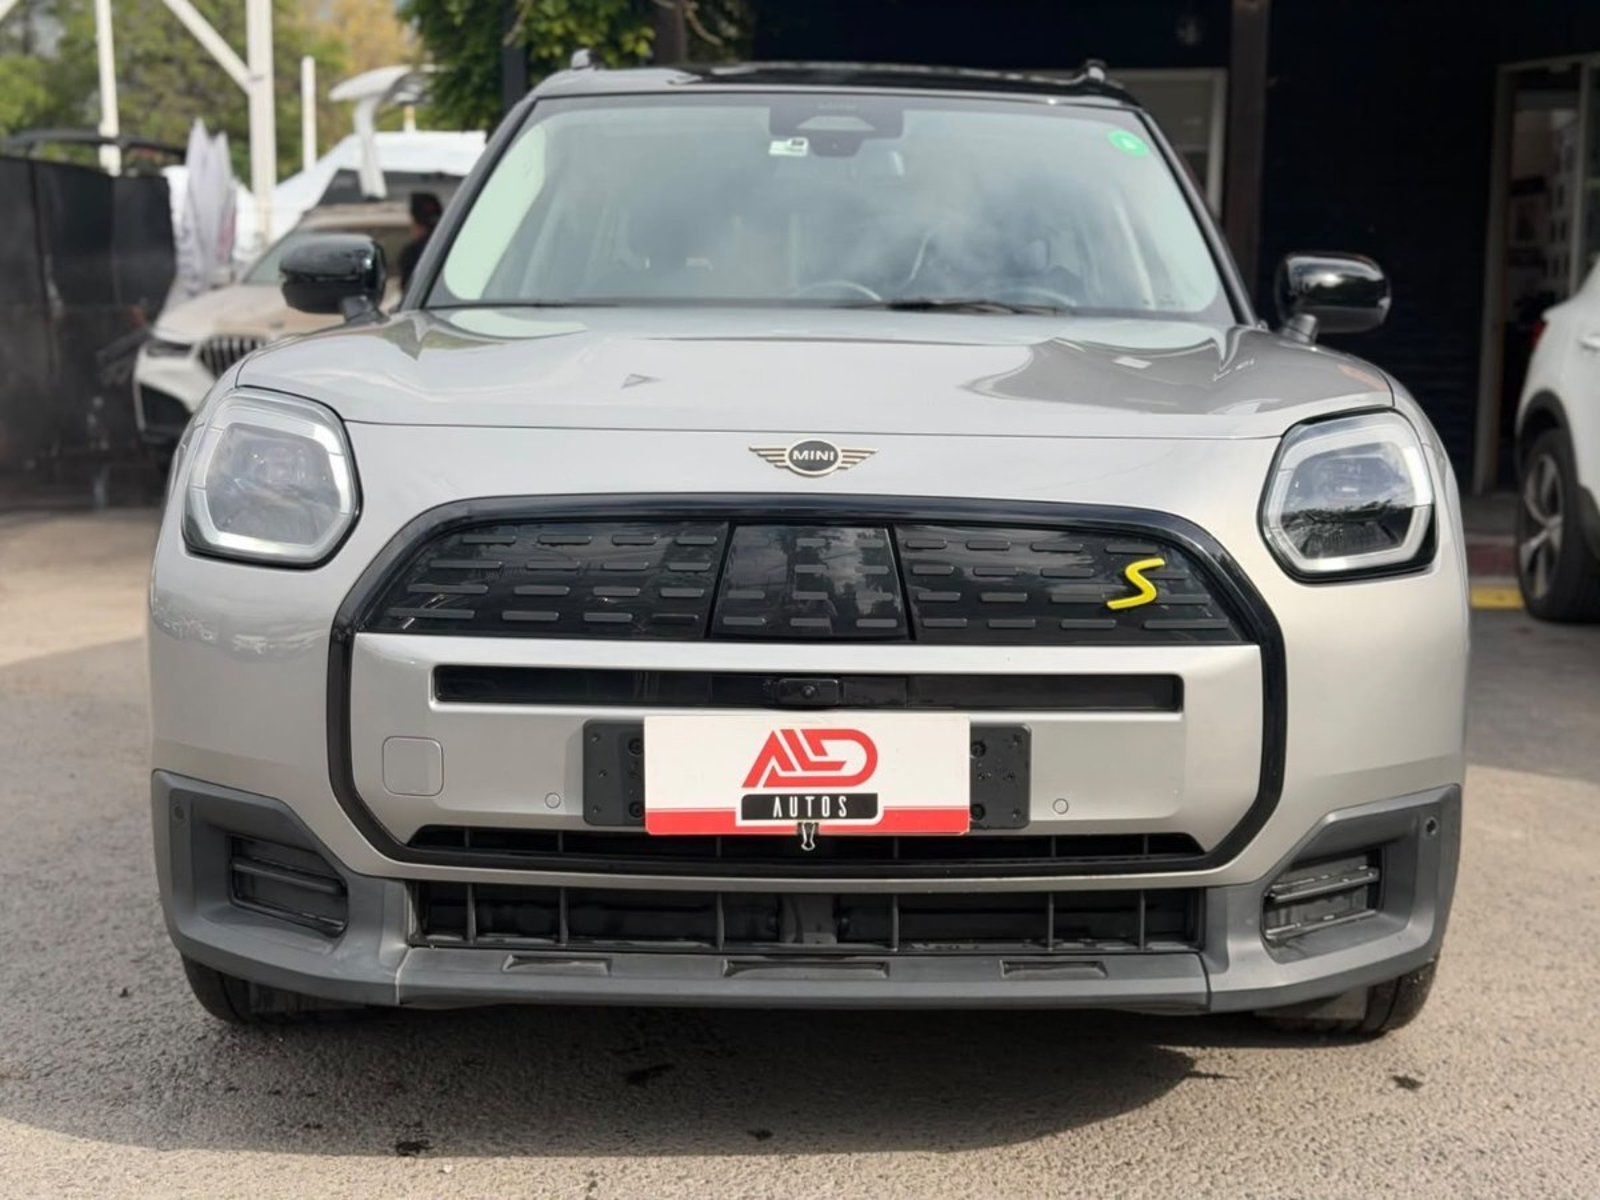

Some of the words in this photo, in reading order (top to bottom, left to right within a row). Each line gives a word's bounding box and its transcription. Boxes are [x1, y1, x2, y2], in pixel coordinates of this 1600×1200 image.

[792, 449, 835, 461] MINI
[1106, 557, 1166, 610] S
[772, 795, 848, 818] AUTOS
